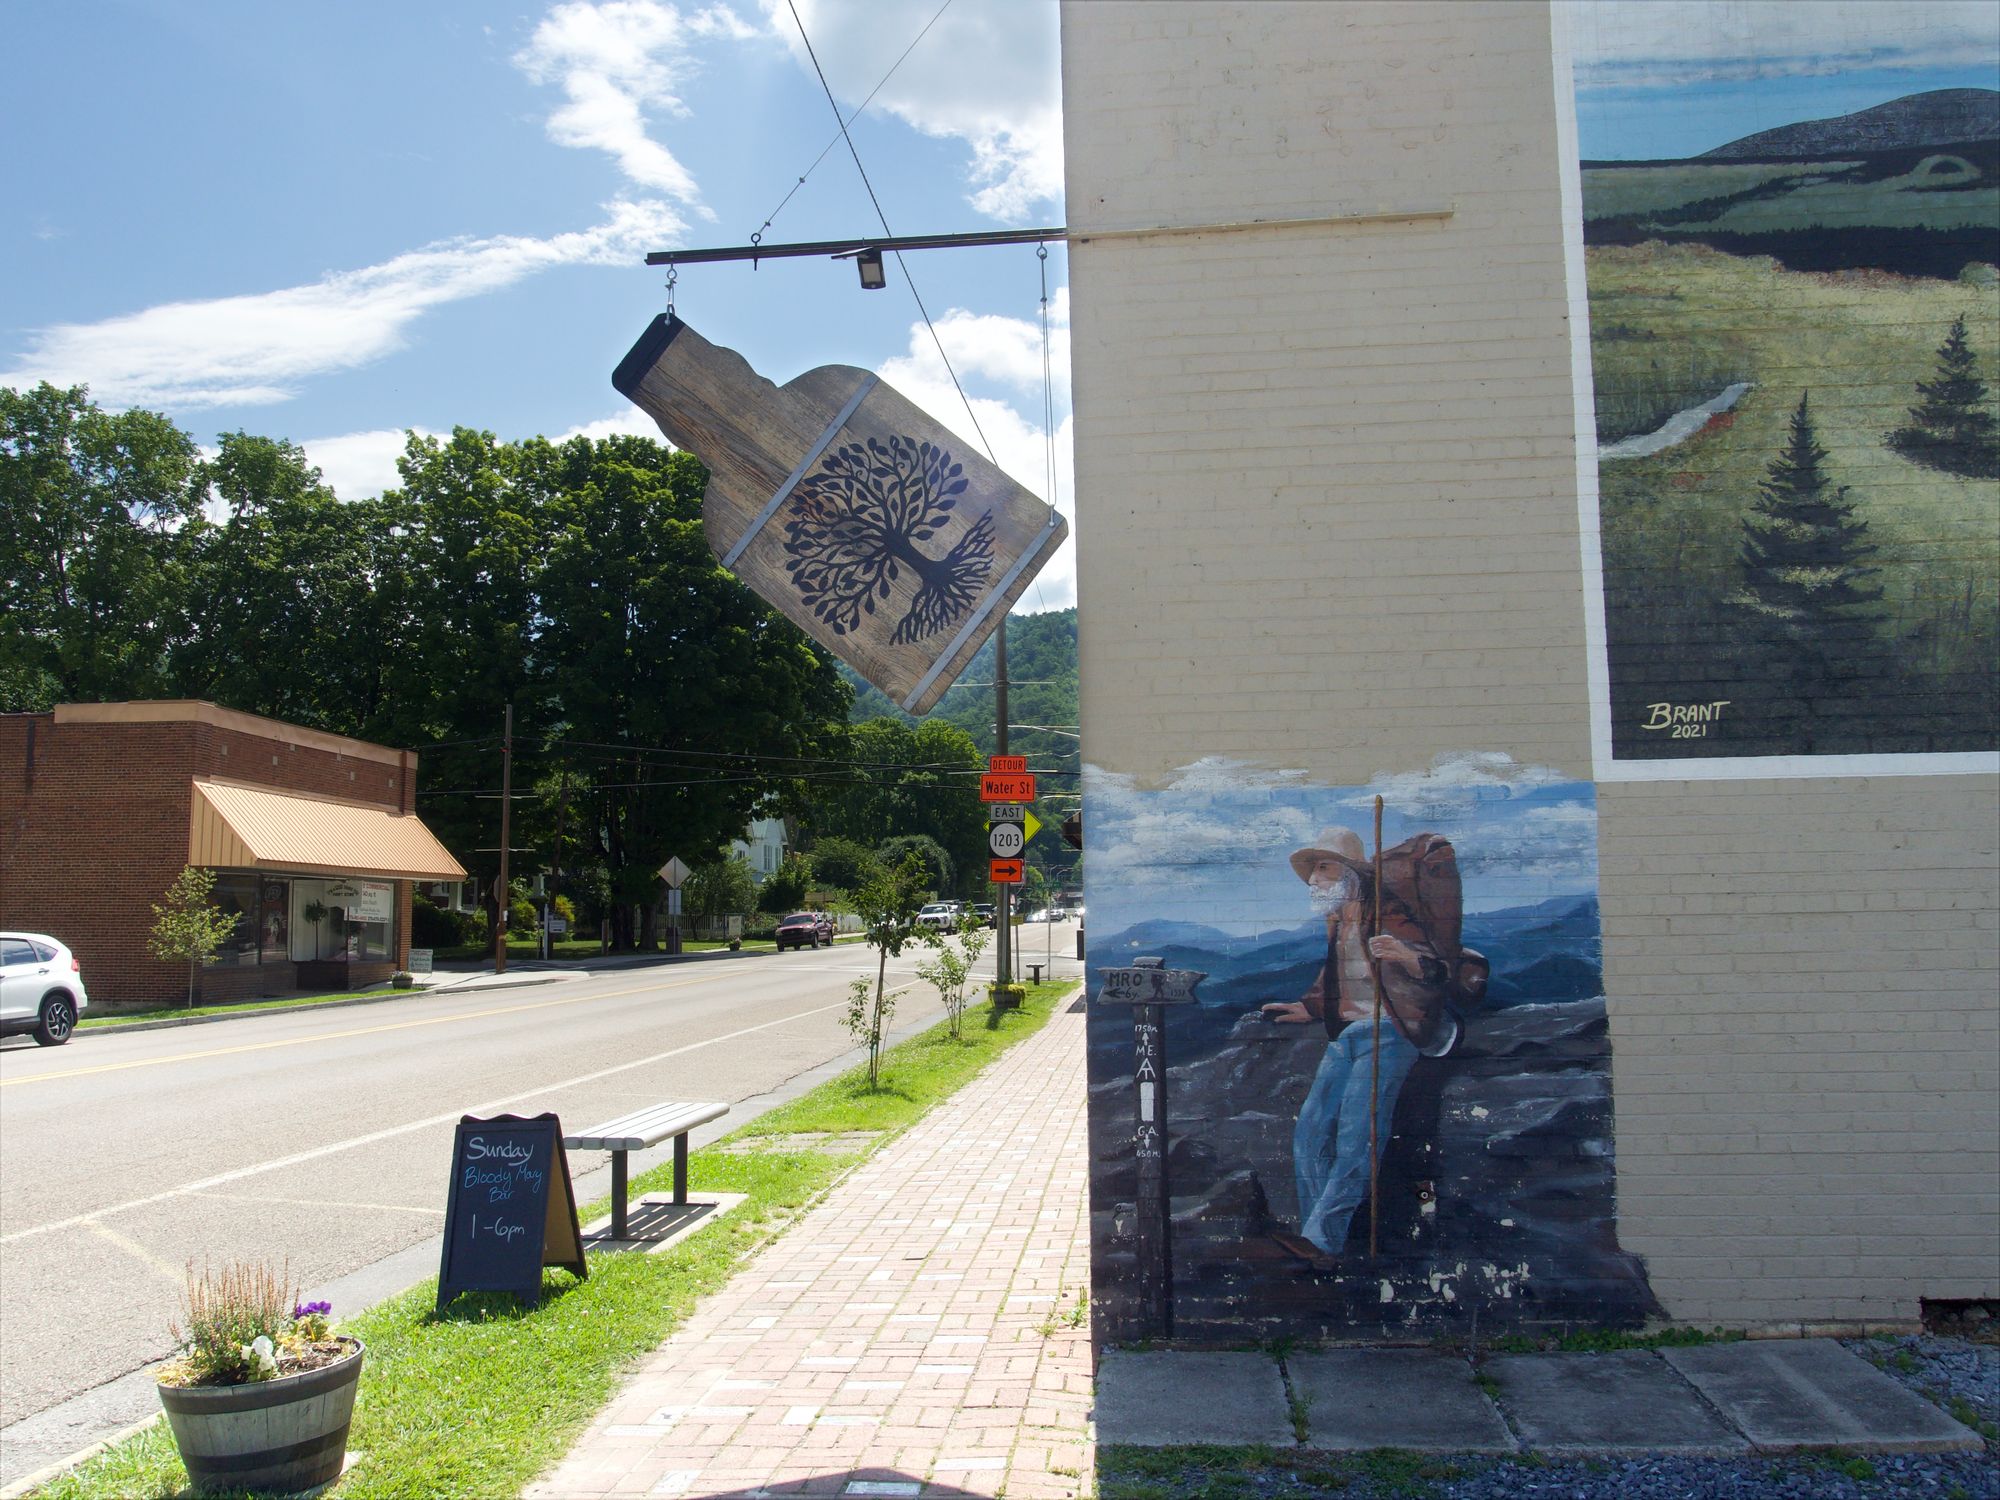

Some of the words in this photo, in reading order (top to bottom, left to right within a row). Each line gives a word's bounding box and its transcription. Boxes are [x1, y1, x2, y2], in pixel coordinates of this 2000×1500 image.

[1641, 701, 1731, 729] BRANT
[1672, 724, 1706, 738] 2021
[993, 760, 1023, 770] DETOUR
[986, 782, 1014, 794] Water
[1020, 782, 1030, 794] St
[995, 808, 1020, 817] EAST
[993, 834, 1020, 847] 1203
[1109, 972, 1143, 987] MRO
[466, 1136, 534, 1167] Sunday
[464, 1166, 512, 1191] Bloody
[515, 1164, 543, 1193] Mary
[489, 1187, 515, 1203] Bar
